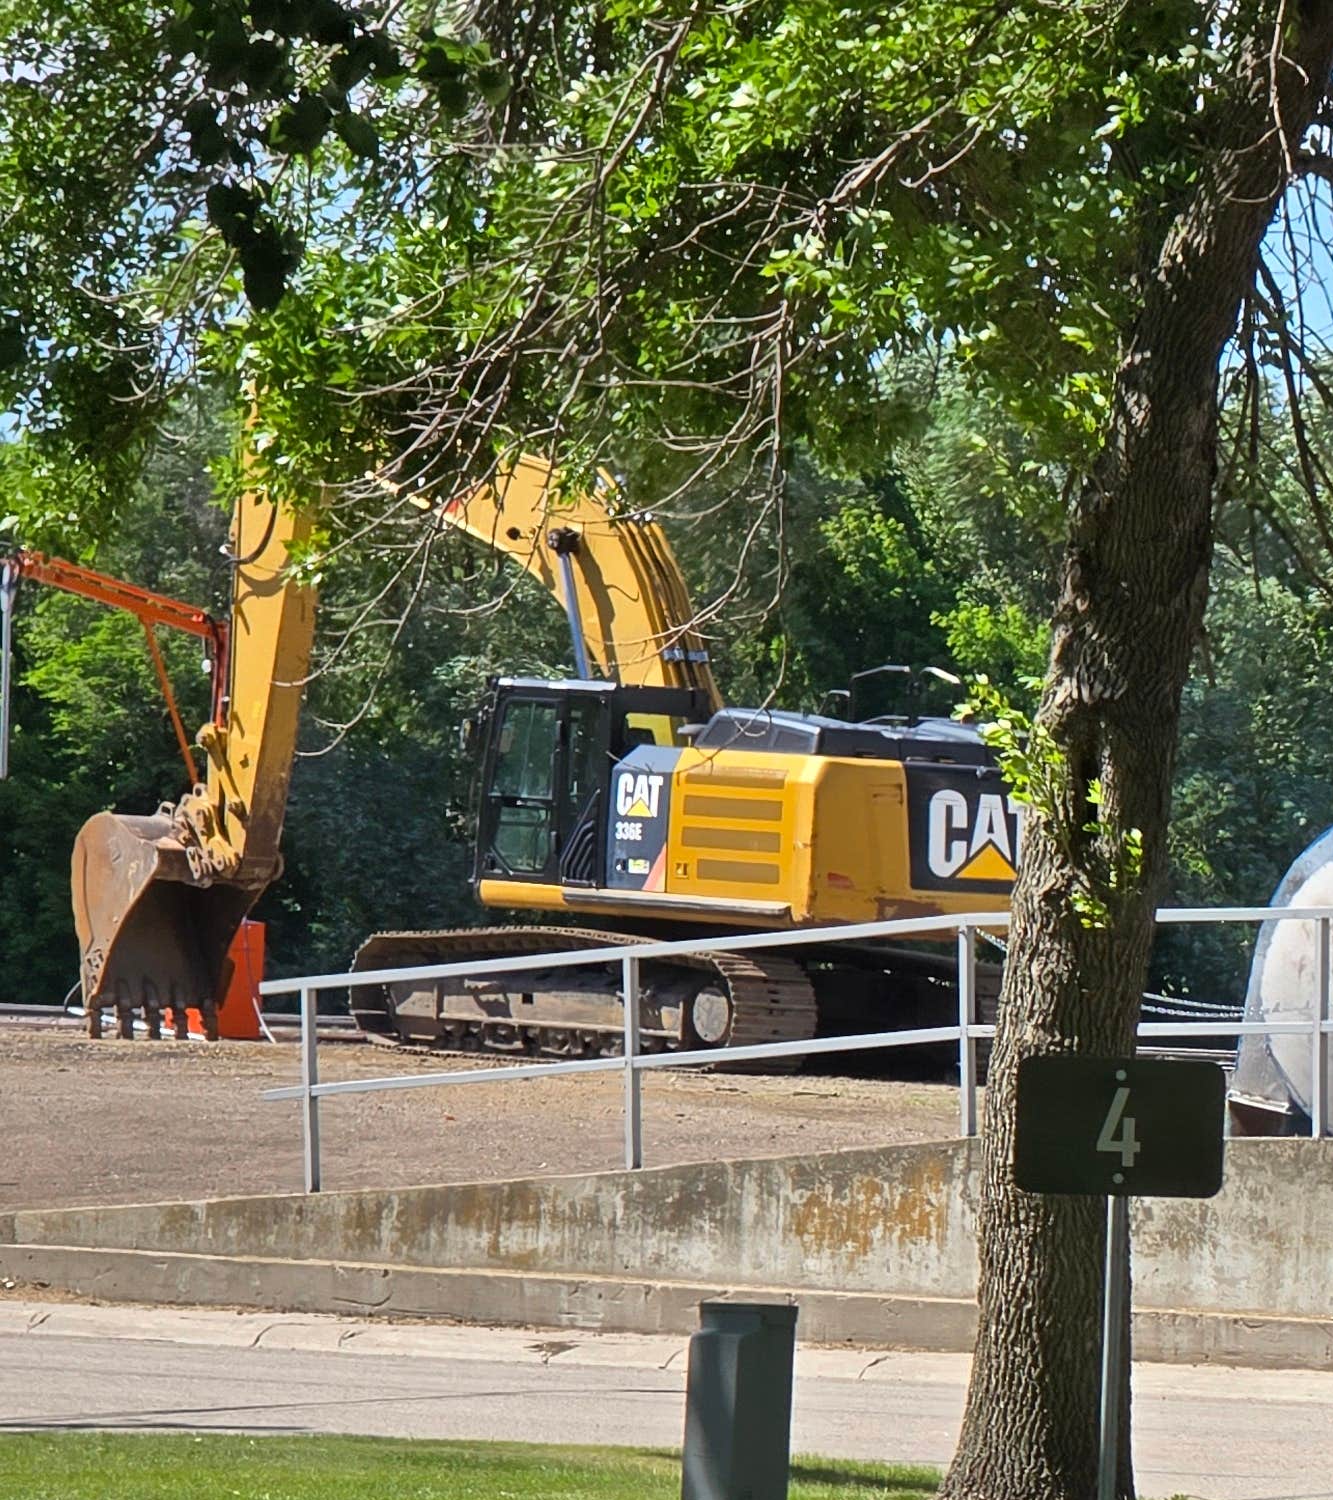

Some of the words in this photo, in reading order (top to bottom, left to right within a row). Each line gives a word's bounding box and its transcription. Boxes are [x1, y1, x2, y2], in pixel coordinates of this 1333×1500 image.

[617, 773, 664, 817] CAT
[615, 821, 642, 840] 336E
[1096, 1087, 1141, 1167] 4
